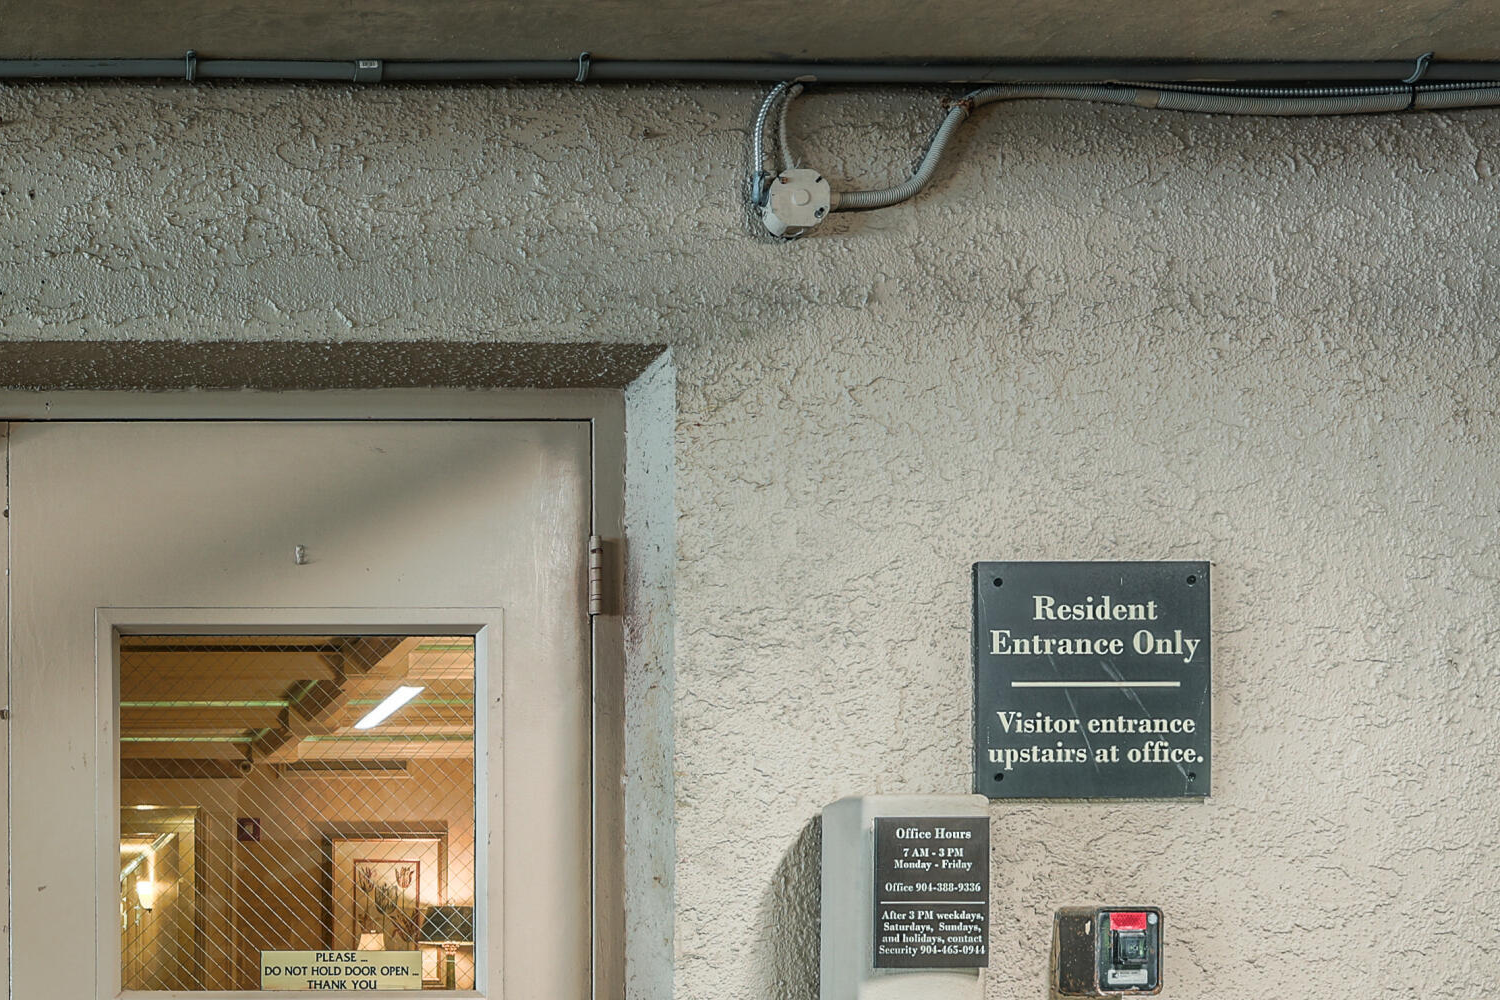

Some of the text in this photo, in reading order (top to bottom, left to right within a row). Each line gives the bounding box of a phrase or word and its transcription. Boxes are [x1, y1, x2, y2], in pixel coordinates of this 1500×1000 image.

[1032, 595, 1158, 621] Resident
[990, 629, 1200, 663] Entrance Only
[997, 711, 1195, 734] Visitor entrance
[988, 741, 1204, 770] upstairs at office.
[896, 828, 971, 839] Office Hours
[903, 848, 909, 857] 7
[912, 848, 929, 857] AM
[939, 848, 945, 857] 3
[947, 848, 964, 857] PM
[894, 859, 932, 871] Monday
[942, 859, 972, 871] Friday
[885, 882, 981, 892] Office 904-388-9336
[882, 910, 984, 922] After 3 PM weekdays,
[884, 922, 981, 933] Saturdays, Sundays,
[882, 933, 899, 942] and
[902, 934, 945, 944] holidays,
[879, 945, 918, 956] Security
[316, 952, 357, 962] PLEASE
[265, 966, 282, 976] DO
[284, 966, 307, 976] NOT
[311, 966, 341, 976] HOLD
[345, 966, 376, 976] DOOR
[381, 966, 409, 976] OPEN
[307, 980, 377, 989] THANK YOU
